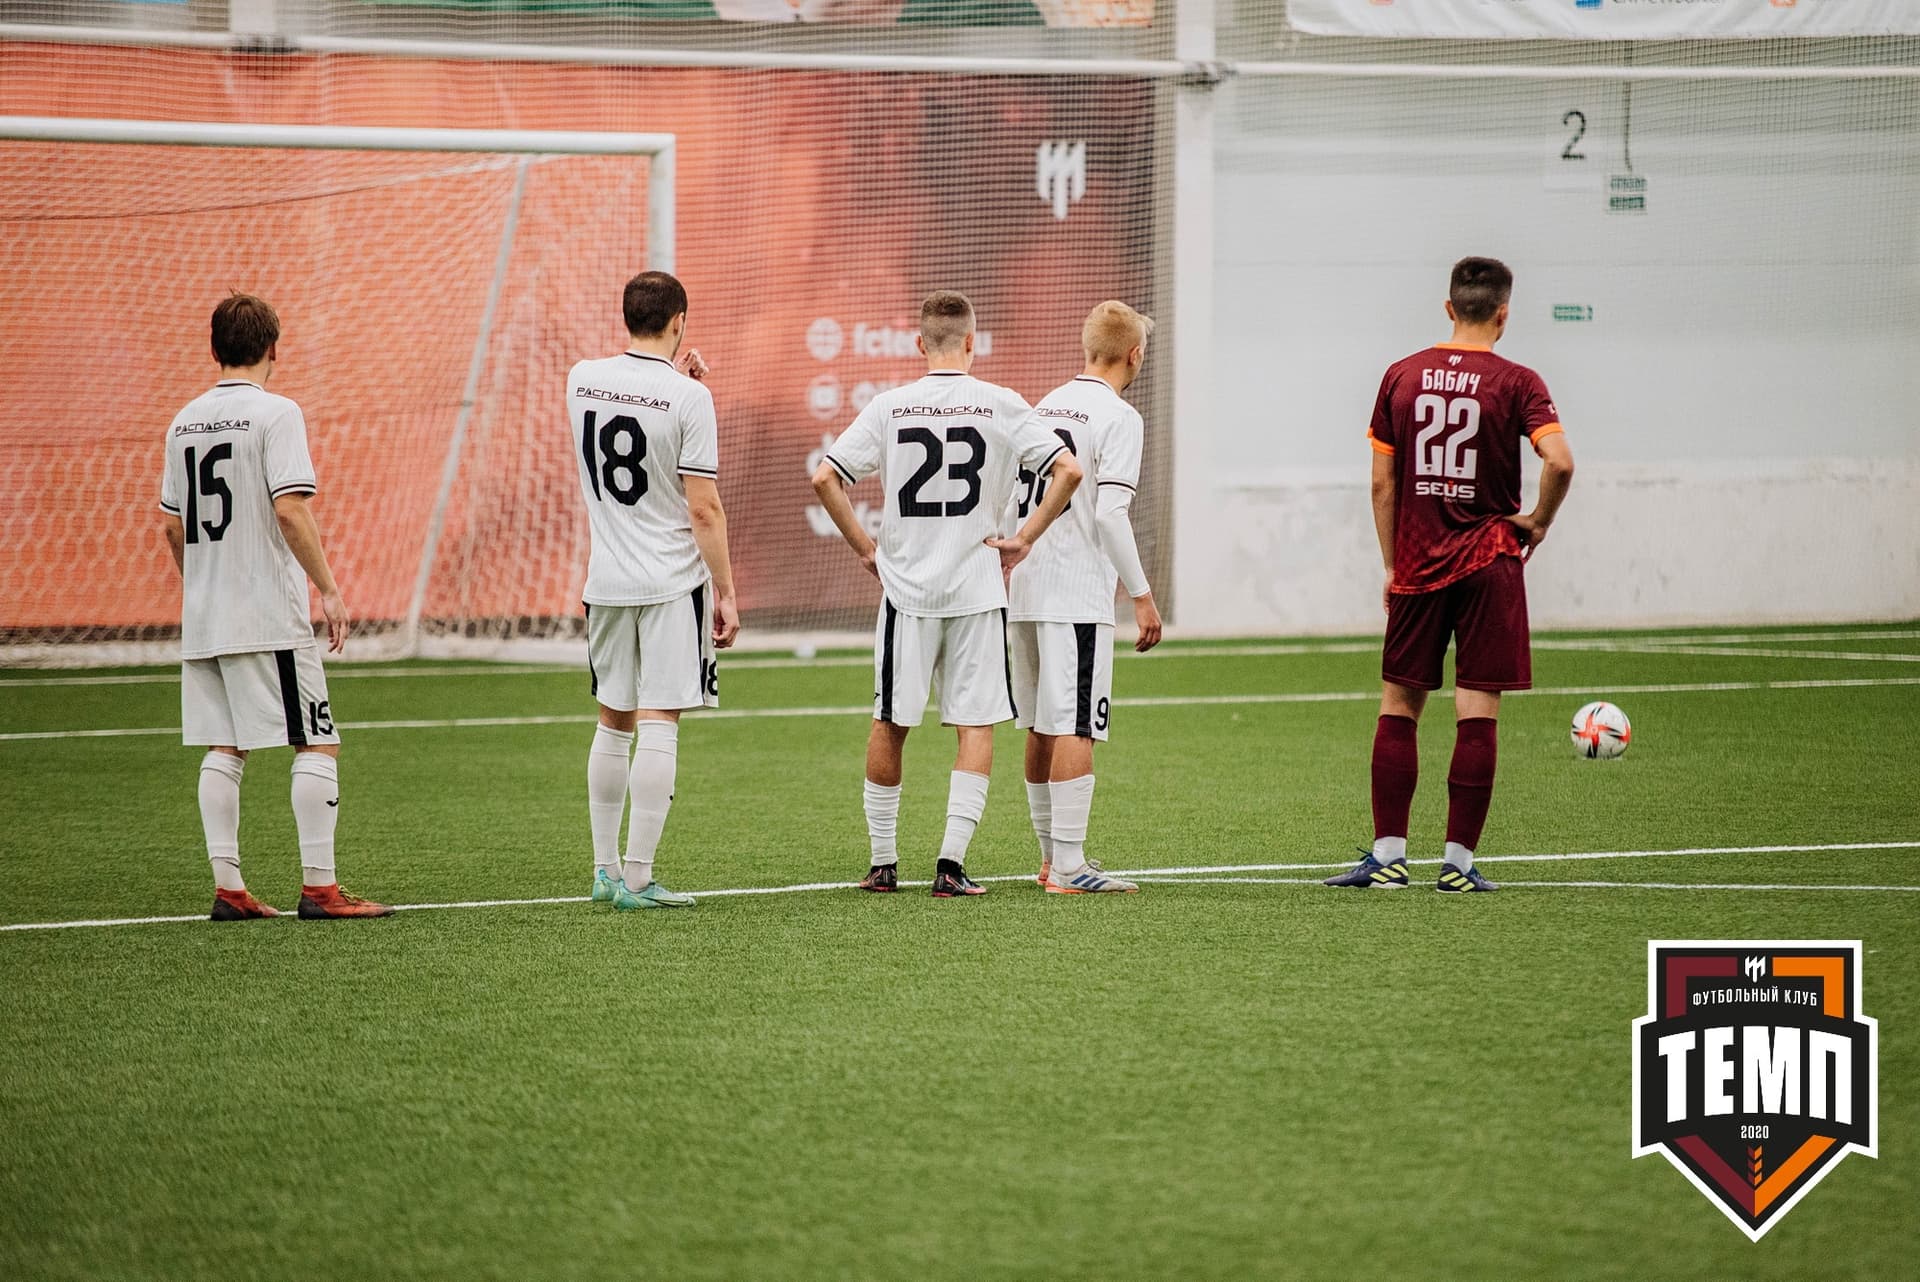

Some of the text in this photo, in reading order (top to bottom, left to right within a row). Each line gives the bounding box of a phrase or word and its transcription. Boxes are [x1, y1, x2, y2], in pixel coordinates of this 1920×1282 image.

[1562, 110, 1586, 160] 2
[1422, 368, 1480, 395] БАБИЧ
[582, 410, 649, 506] 18
[1415, 393, 1480, 479] 22
[184, 443, 233, 544] 15
[897, 427, 986, 517] 23
[1415, 481, 1476, 499] SEUS
[309, 701, 333, 736] 15
